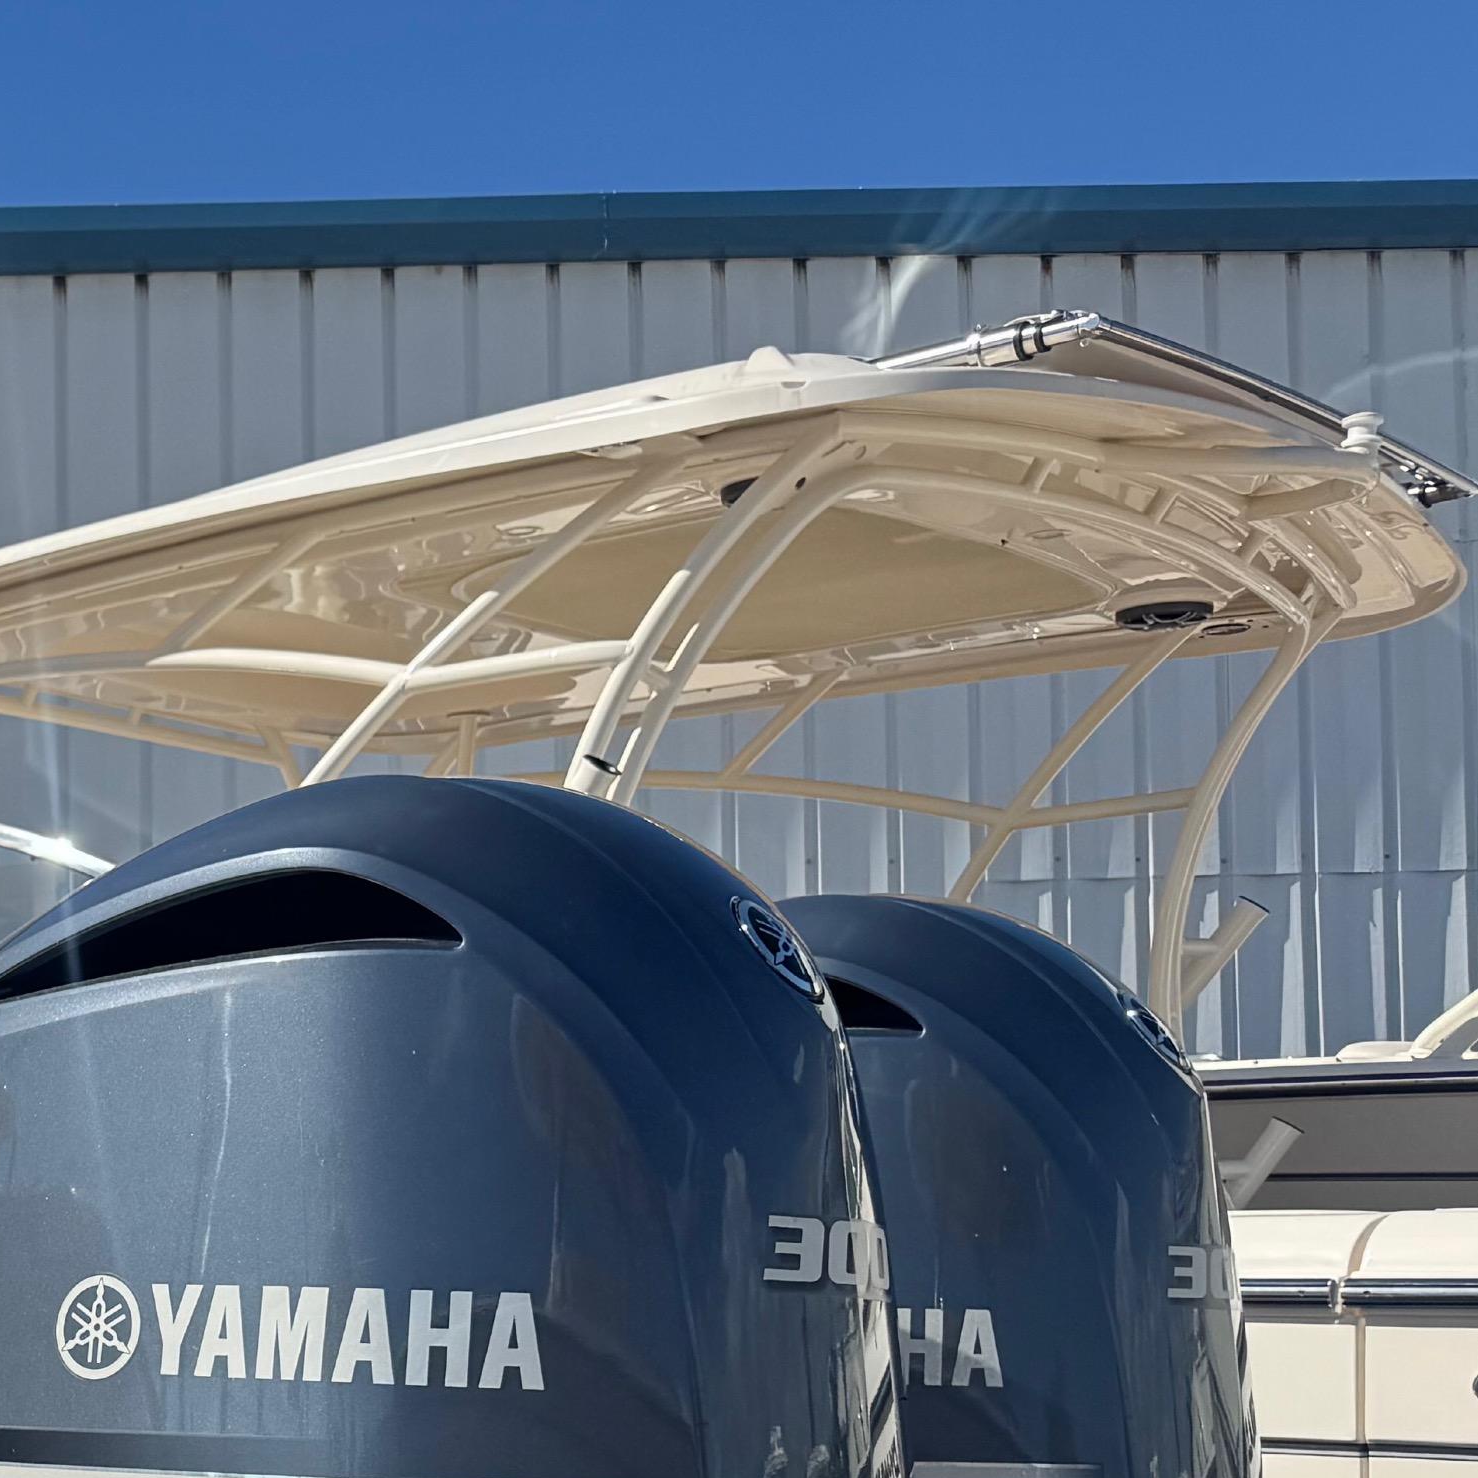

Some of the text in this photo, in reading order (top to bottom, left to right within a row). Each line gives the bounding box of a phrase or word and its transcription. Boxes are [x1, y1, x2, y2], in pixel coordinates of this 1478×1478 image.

[763, 1215, 890, 1291] 300
[1167, 1245, 1241, 1300] 30
[152, 1283, 545, 1391] YAMAHA
